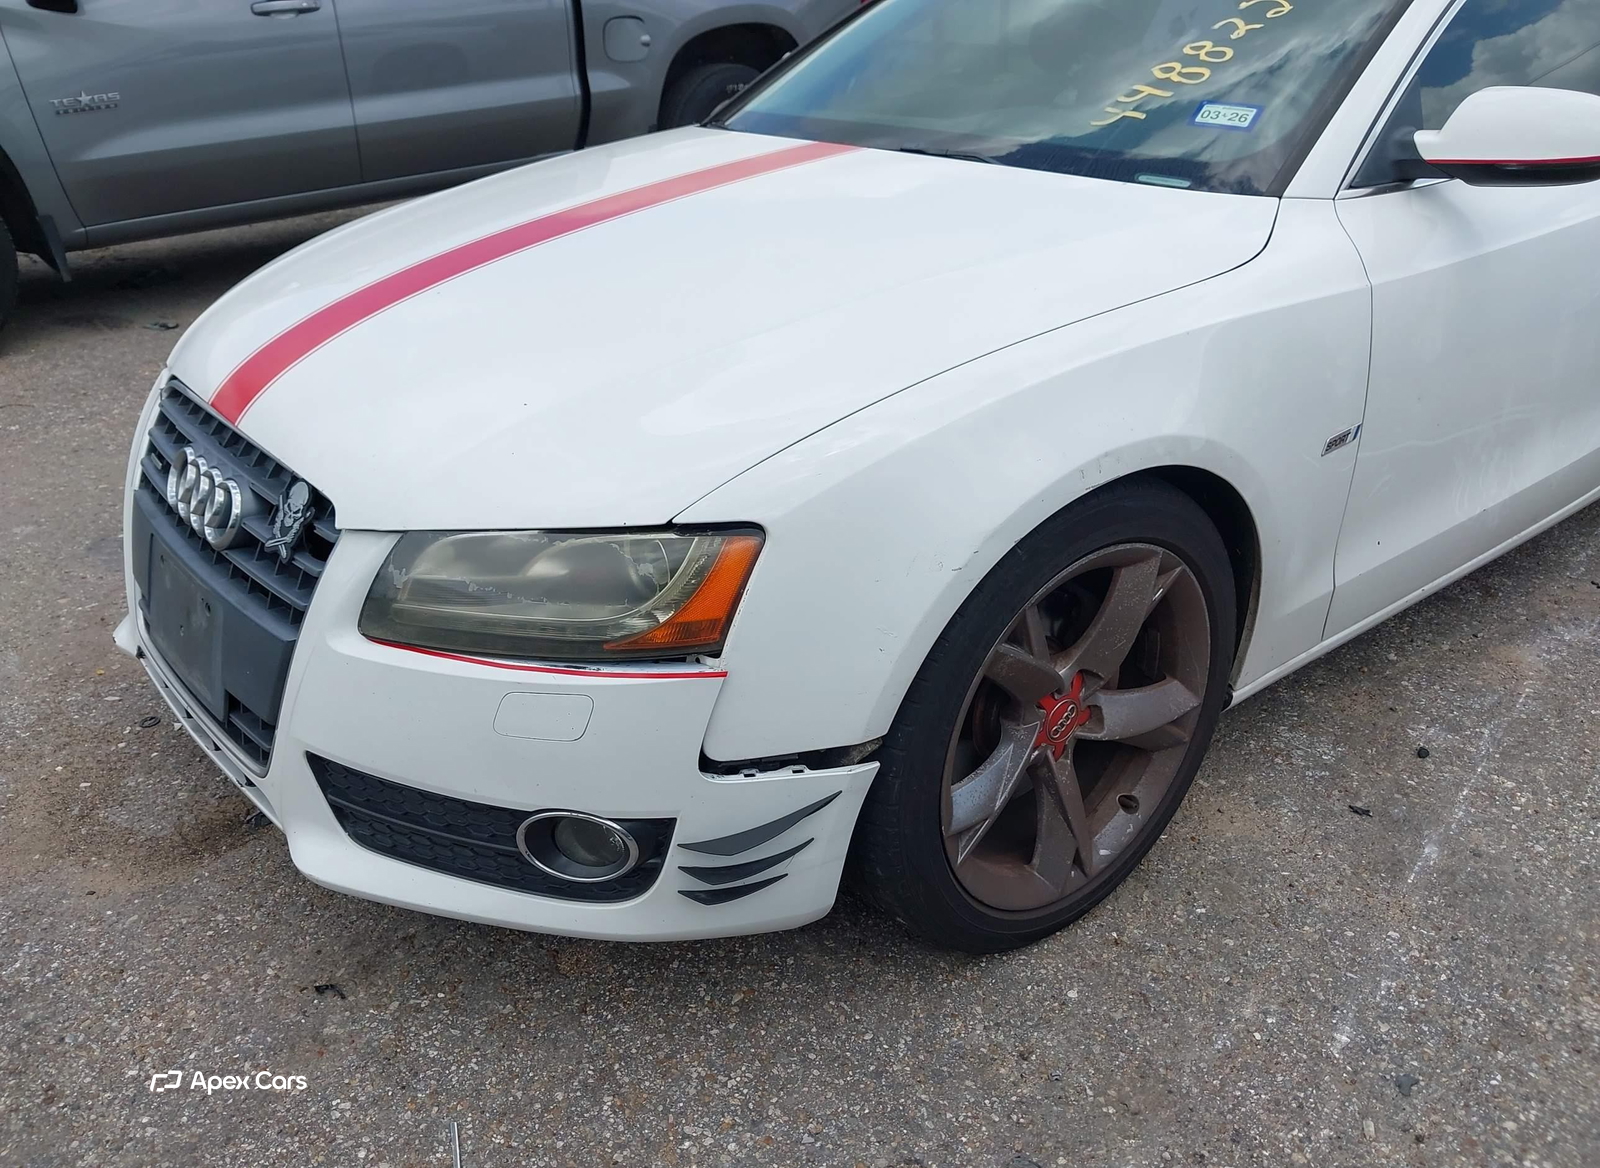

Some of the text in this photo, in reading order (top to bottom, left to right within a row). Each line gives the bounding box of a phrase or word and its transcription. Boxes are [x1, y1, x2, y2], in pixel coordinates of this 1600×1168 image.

[1200, 109, 1250, 123] 03 26
[1325, 430, 1352, 452] SPORT
